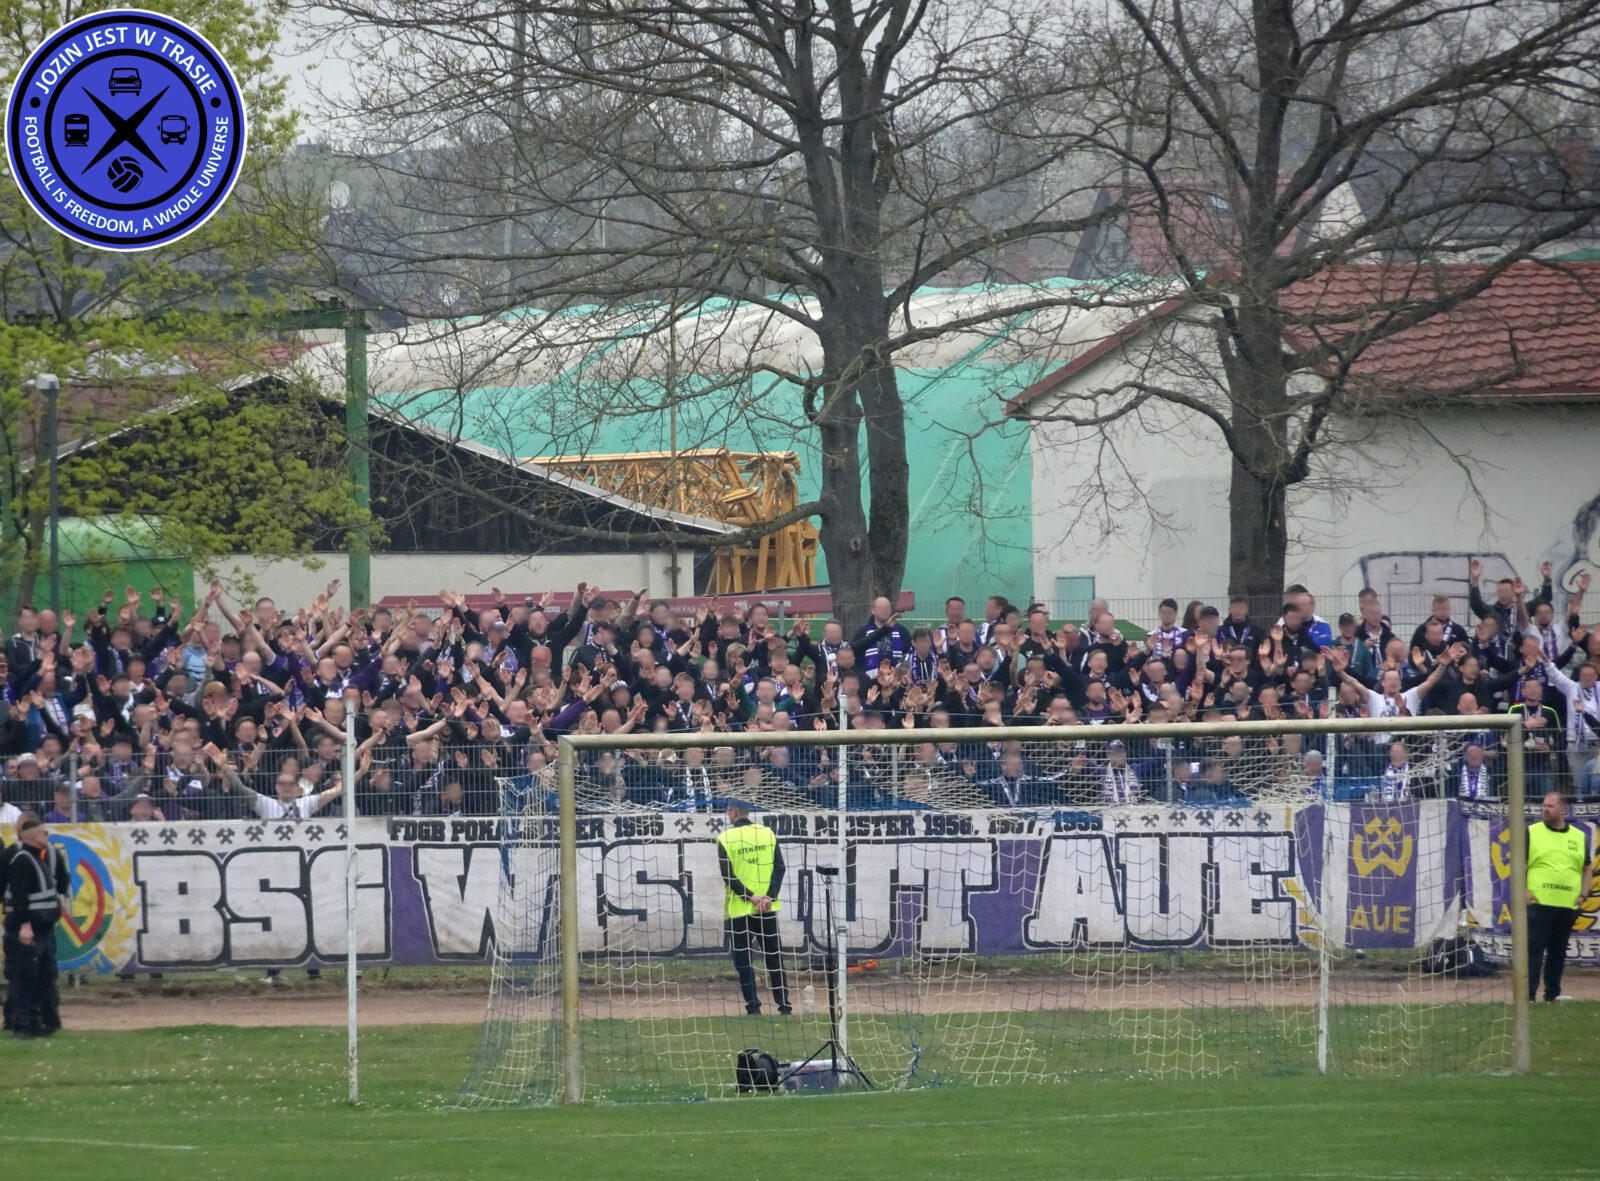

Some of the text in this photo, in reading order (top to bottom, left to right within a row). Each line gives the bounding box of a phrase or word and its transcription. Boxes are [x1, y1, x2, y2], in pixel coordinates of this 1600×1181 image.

[391, 818, 446, 842] FDGB
[613, 815, 665, 839] 1955
[815, 814, 915, 837] MISTER
[133, 843, 391, 967] BSG
[1023, 831, 1298, 949] AUE
[1542, 882, 1572, 892] STEWARD
[1352, 905, 1411, 934] AUE
